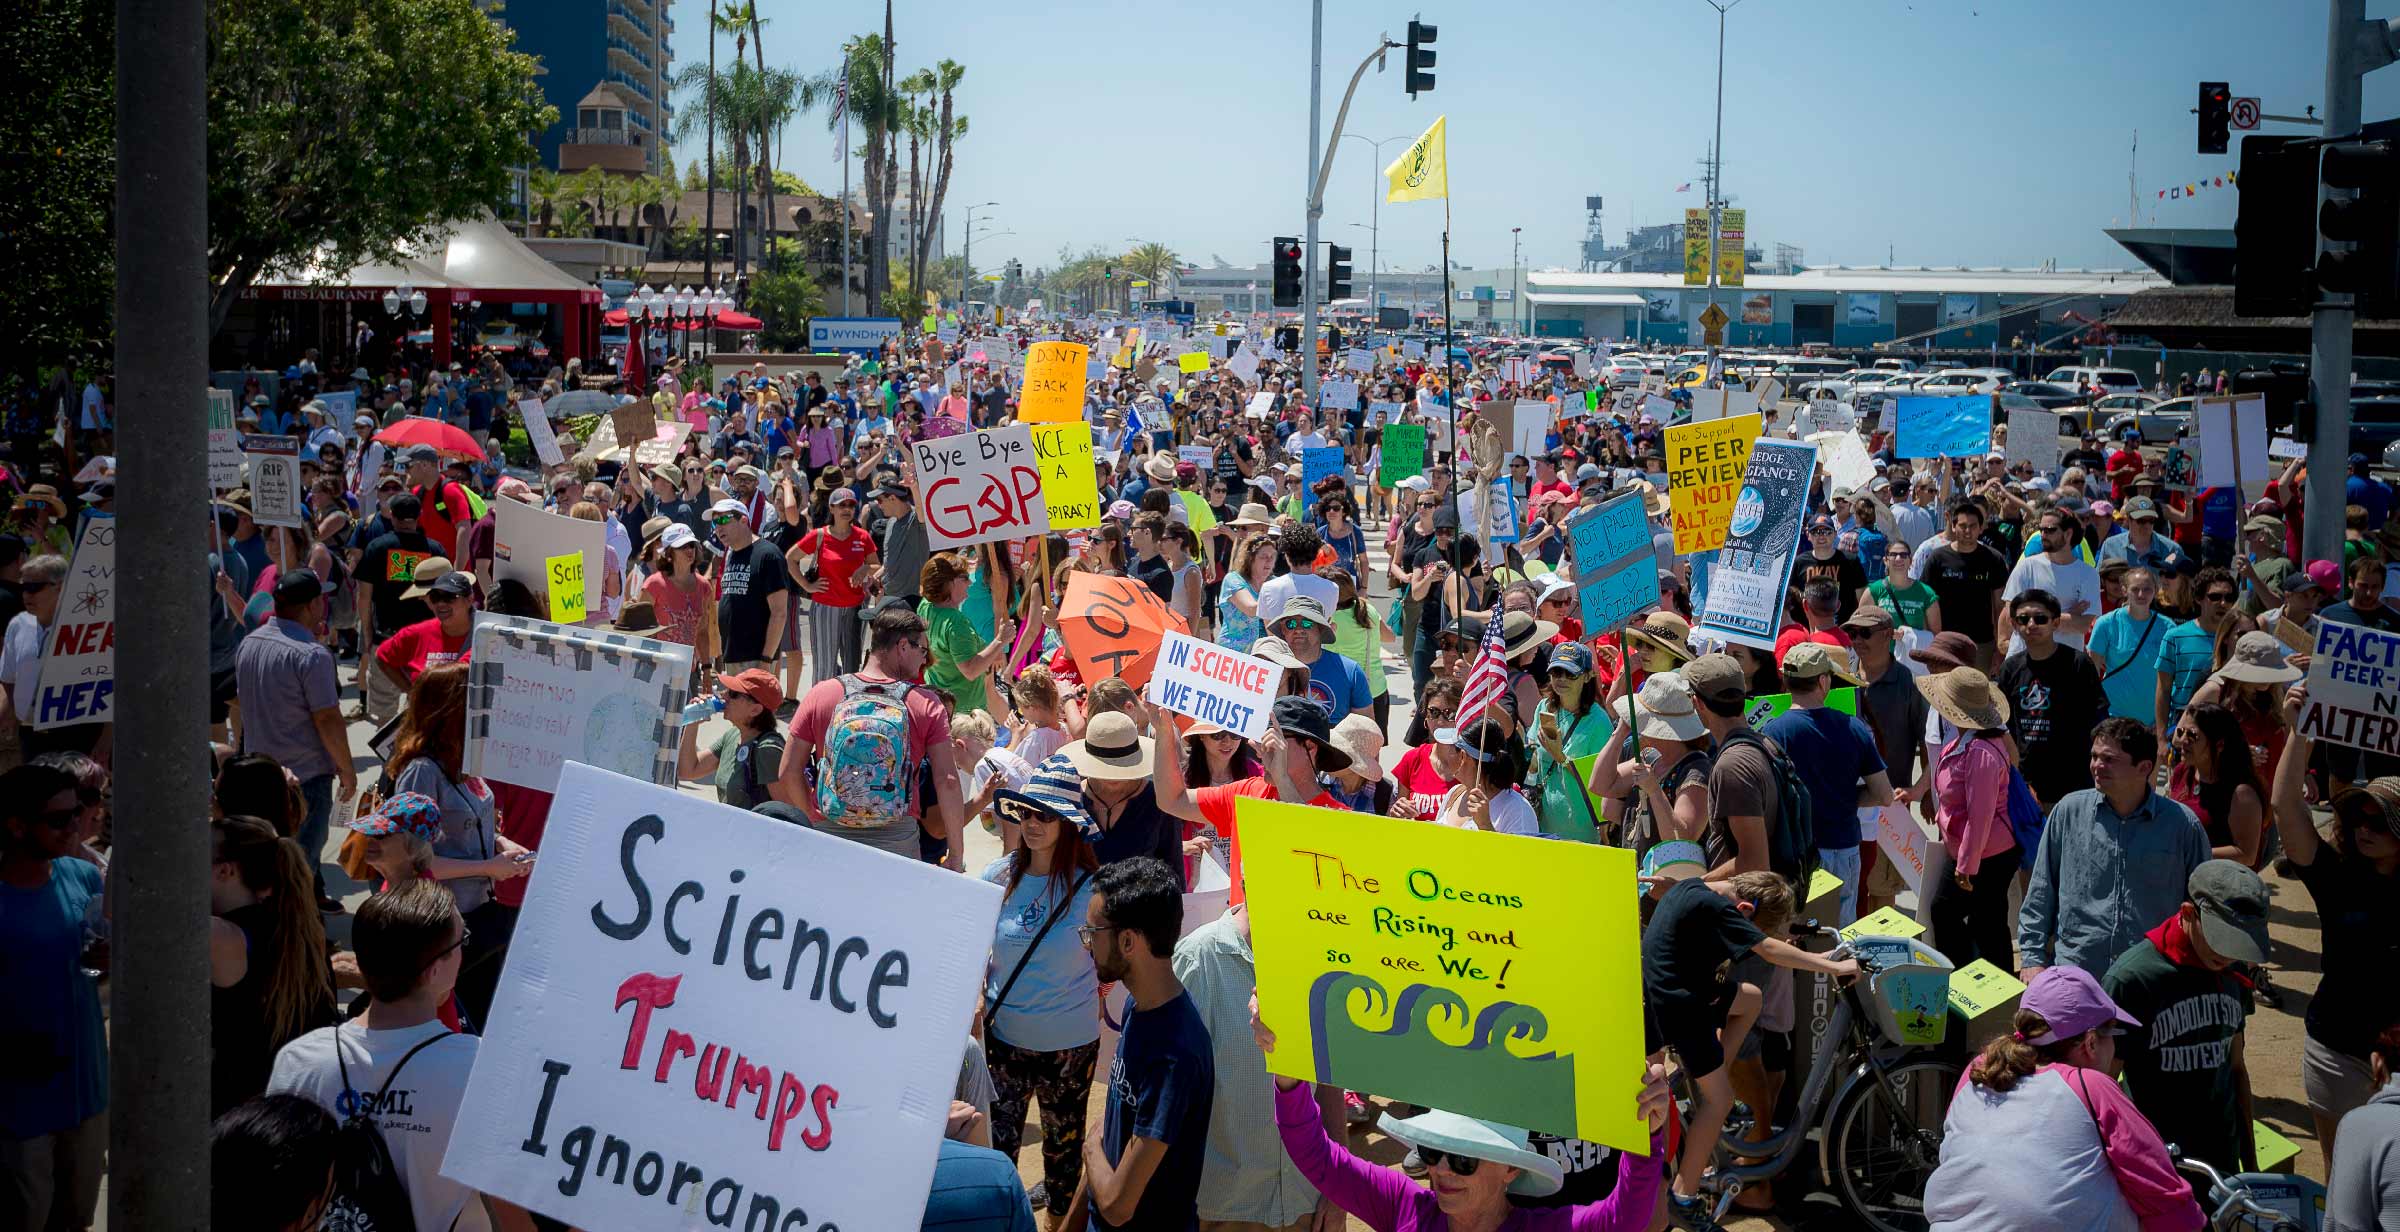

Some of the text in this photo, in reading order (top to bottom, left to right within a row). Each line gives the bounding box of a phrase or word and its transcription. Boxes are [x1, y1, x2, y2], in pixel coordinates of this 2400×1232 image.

[1655, 234, 1670, 250] 41
[239, 288, 260, 300] ER
[282, 288, 378, 301] RESTAURANT
[832, 327, 899, 341] WYNDHAM
[1036, 347, 1080, 365] DON'T
[1032, 379, 1069, 393] BACK
[1670, 421, 1735, 443] We Support
[918, 432, 1025, 475] Bye Bye
[1679, 438, 1745, 466] PEER
[263, 463, 283, 476] RIP
[1669, 460, 1749, 490] REVIEW
[1692, 483, 1734, 507] NOT
[1737, 501, 1764, 519] ARTH
[1573, 522, 1598, 549] NOT
[1678, 527, 1729, 552] FAC
[1586, 581, 1609, 608] WE
[1594, 576, 1658, 628] SCIENCE!
[1168, 640, 1270, 695] IN SCIENCE
[2330, 660, 2400, 690] PEER-
[1162, 679, 1254, 732] WE TRUST
[2300, 701, 2400, 757] ALTER
[1291, 849, 1523, 909] The Oceans
[591, 813, 910, 1029] Science
[1373, 907, 1458, 951] Rising
[1466, 930, 1523, 950] and
[1326, 949, 1351, 965] so
[615, 971, 839, 1152] Trumps
[522, 1059, 841, 1232] Ignoranc
